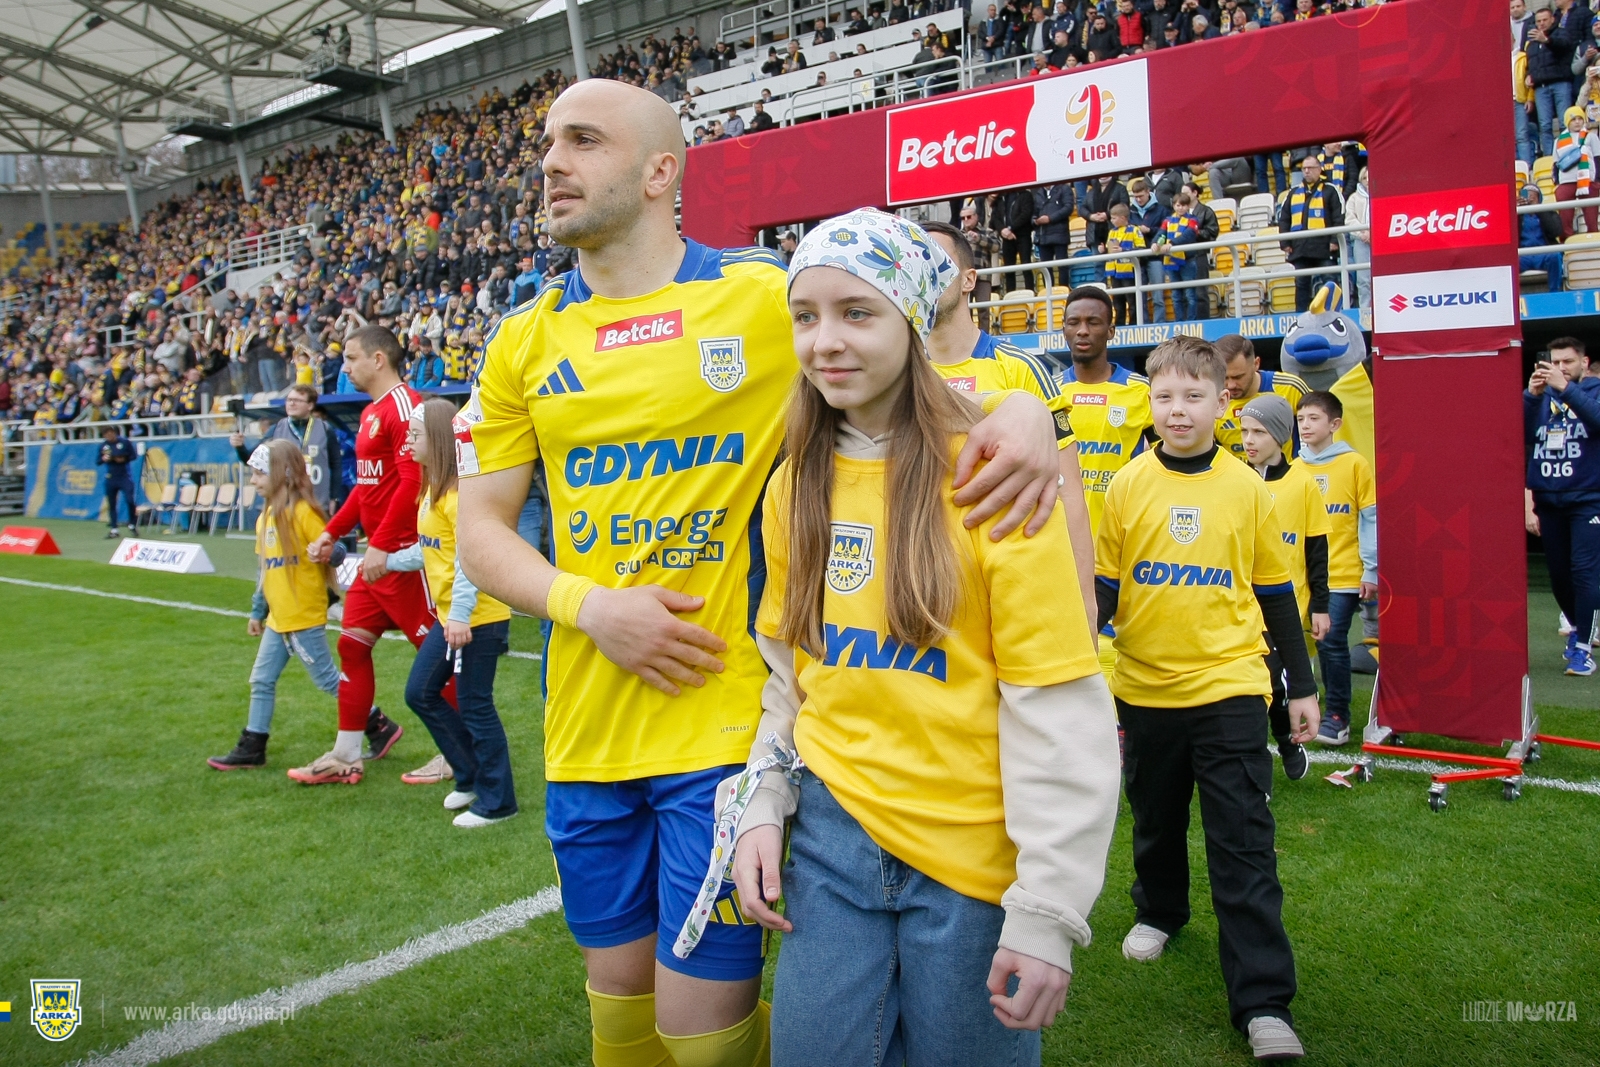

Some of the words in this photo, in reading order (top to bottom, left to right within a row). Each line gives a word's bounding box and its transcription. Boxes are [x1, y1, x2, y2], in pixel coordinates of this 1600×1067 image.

[897, 121, 1016, 172] Betclic
[1066, 149, 1075, 165] 1
[1081, 142, 1118, 162] LIGA
[1388, 205, 1489, 238] Betclic
[1412, 291, 1497, 308] SUZUKI
[602, 318, 675, 347] Betclic
[1239, 318, 1275, 336] ARKA
[1038, 334, 1067, 351] NIGD
[1074, 395, 1105, 404] Betclic
[564, 432, 745, 488] GDYNIA
[1540, 461, 1574, 478] 016
[137, 548, 187, 566] SUZUKI
[829, 559, 864, 571] ARKA
[1132, 560, 1233, 590] GDYNIA
